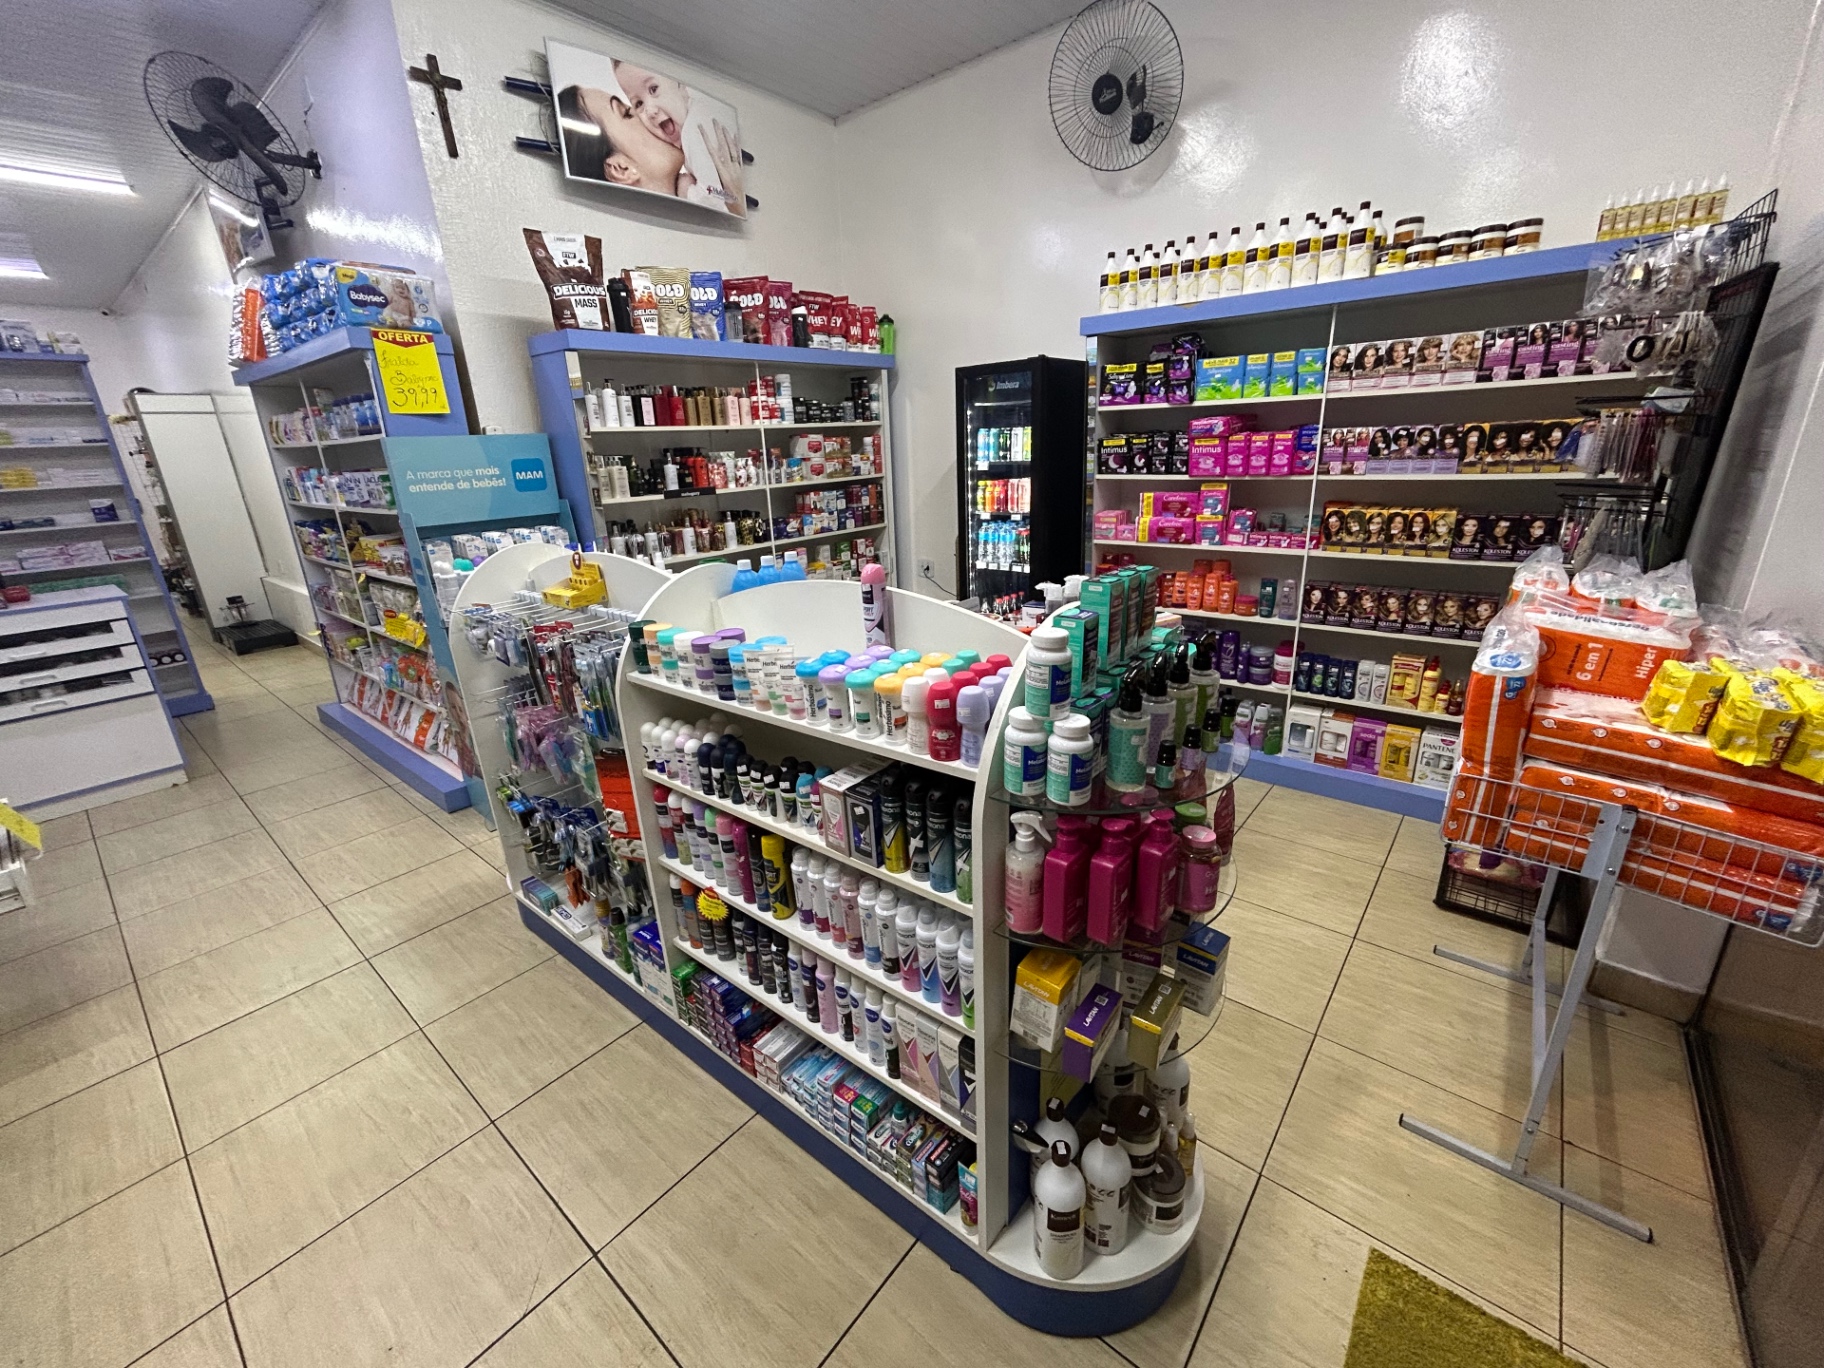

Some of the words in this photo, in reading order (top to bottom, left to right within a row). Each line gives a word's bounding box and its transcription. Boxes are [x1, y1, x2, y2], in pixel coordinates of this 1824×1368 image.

[349, 290, 386, 303] Babysec
[552, 284, 606, 296] DELICIOUS
[654, 284, 684, 297] OLD
[574, 298, 598, 308] MASS
[830, 316, 843, 328] EY
[378, 331, 429, 344] OFERTA
[1518, 344, 1546, 352] casting
[392, 387, 438, 408] 39,99
[1101, 446, 1128, 454] Intimus
[1191, 446, 1222, 454] Intimus
[406, 470, 414, 480] A
[417, 470, 451, 480] marca
[454, 468, 474, 479] que
[475, 466, 500, 476] mais
[515, 470, 544, 480] MAM
[408, 480, 454, 493] entende
[456, 480, 470, 490] de
[472, 478, 507, 488] bebês!
[1378, 620, 1402, 628] KOLESTON
[1588, 642, 1604, 650] 1
[1585, 652, 1600, 671] em
[1634, 646, 1657, 679] Hiper
[1576, 672, 1592, 681] 6
[1022, 980, 1051, 998] LAVITAN
[1148, 994, 1164, 1015] LAVITAN
[1082, 1006, 1099, 1027] LAVITAN
